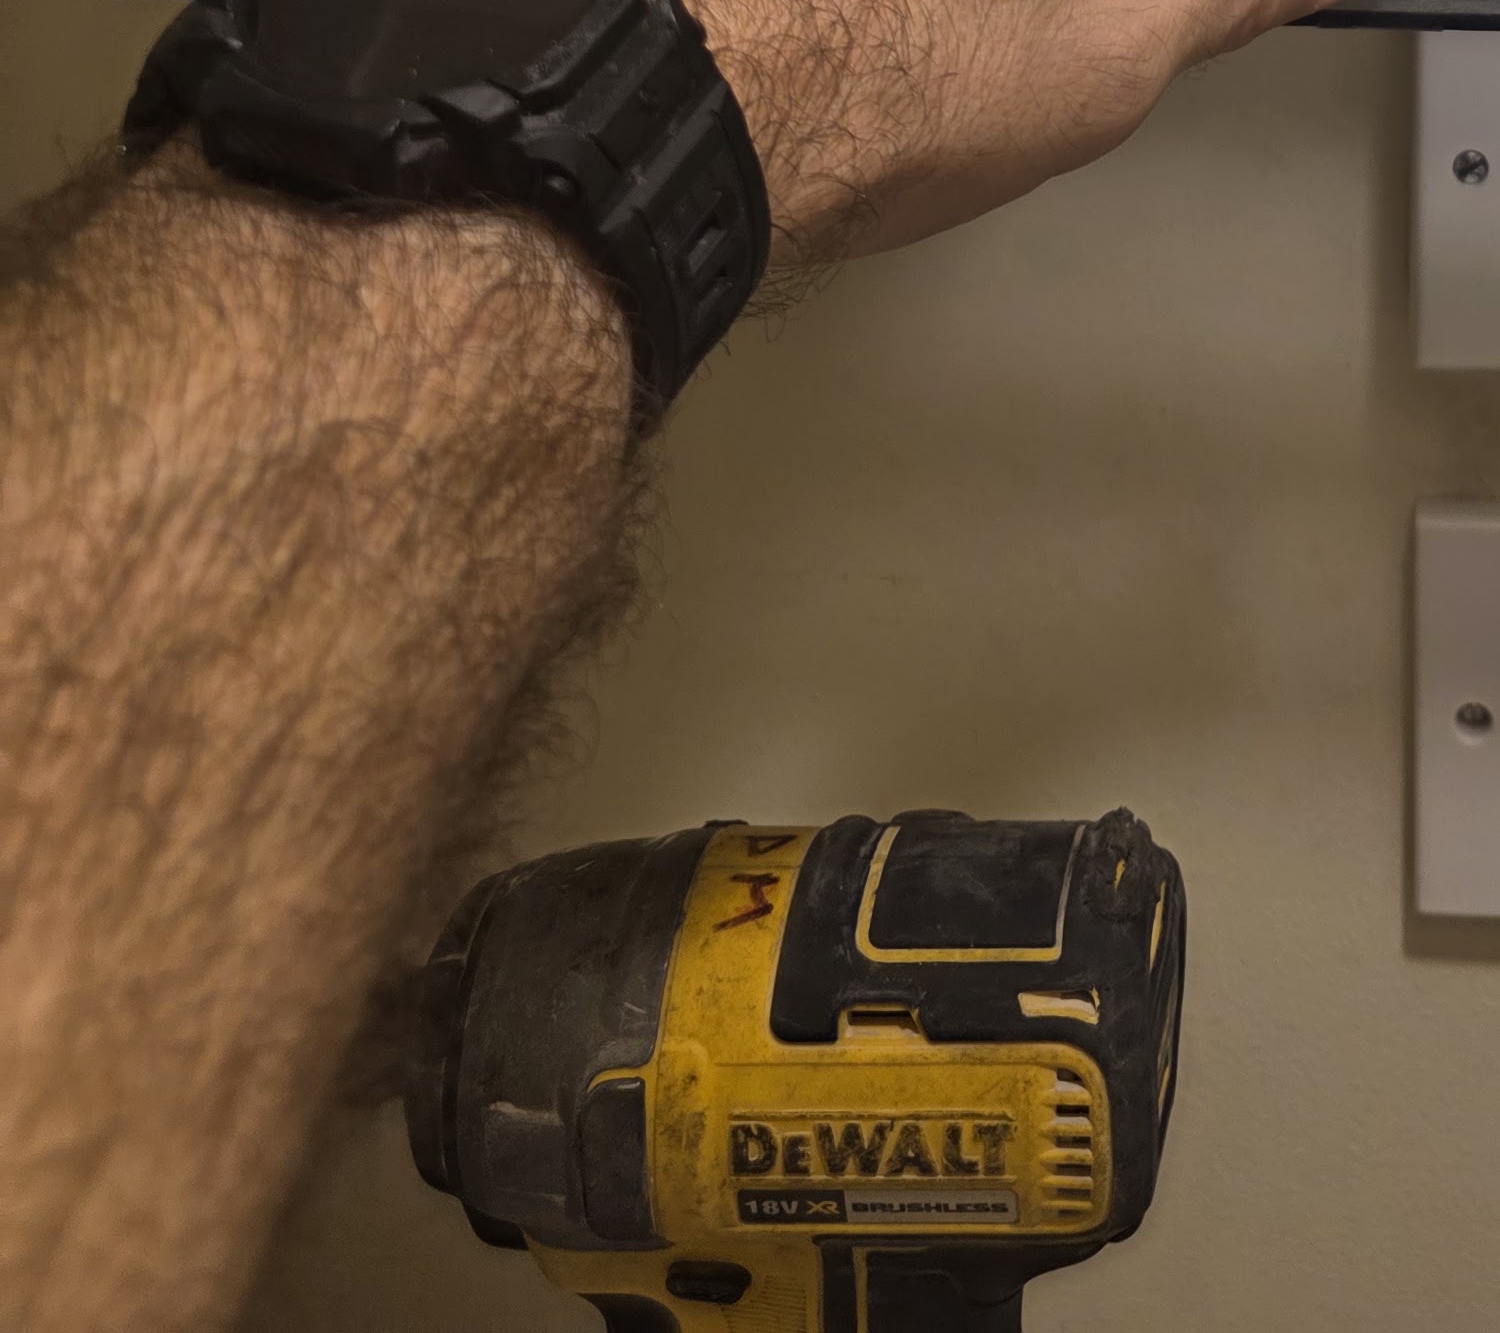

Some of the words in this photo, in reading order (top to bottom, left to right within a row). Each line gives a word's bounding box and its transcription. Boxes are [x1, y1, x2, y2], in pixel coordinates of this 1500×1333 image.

[745, 1200, 799, 1215] 18V
[805, 1200, 840, 1215] XR
[851, 1202, 1009, 1214] BRUSHLESS
